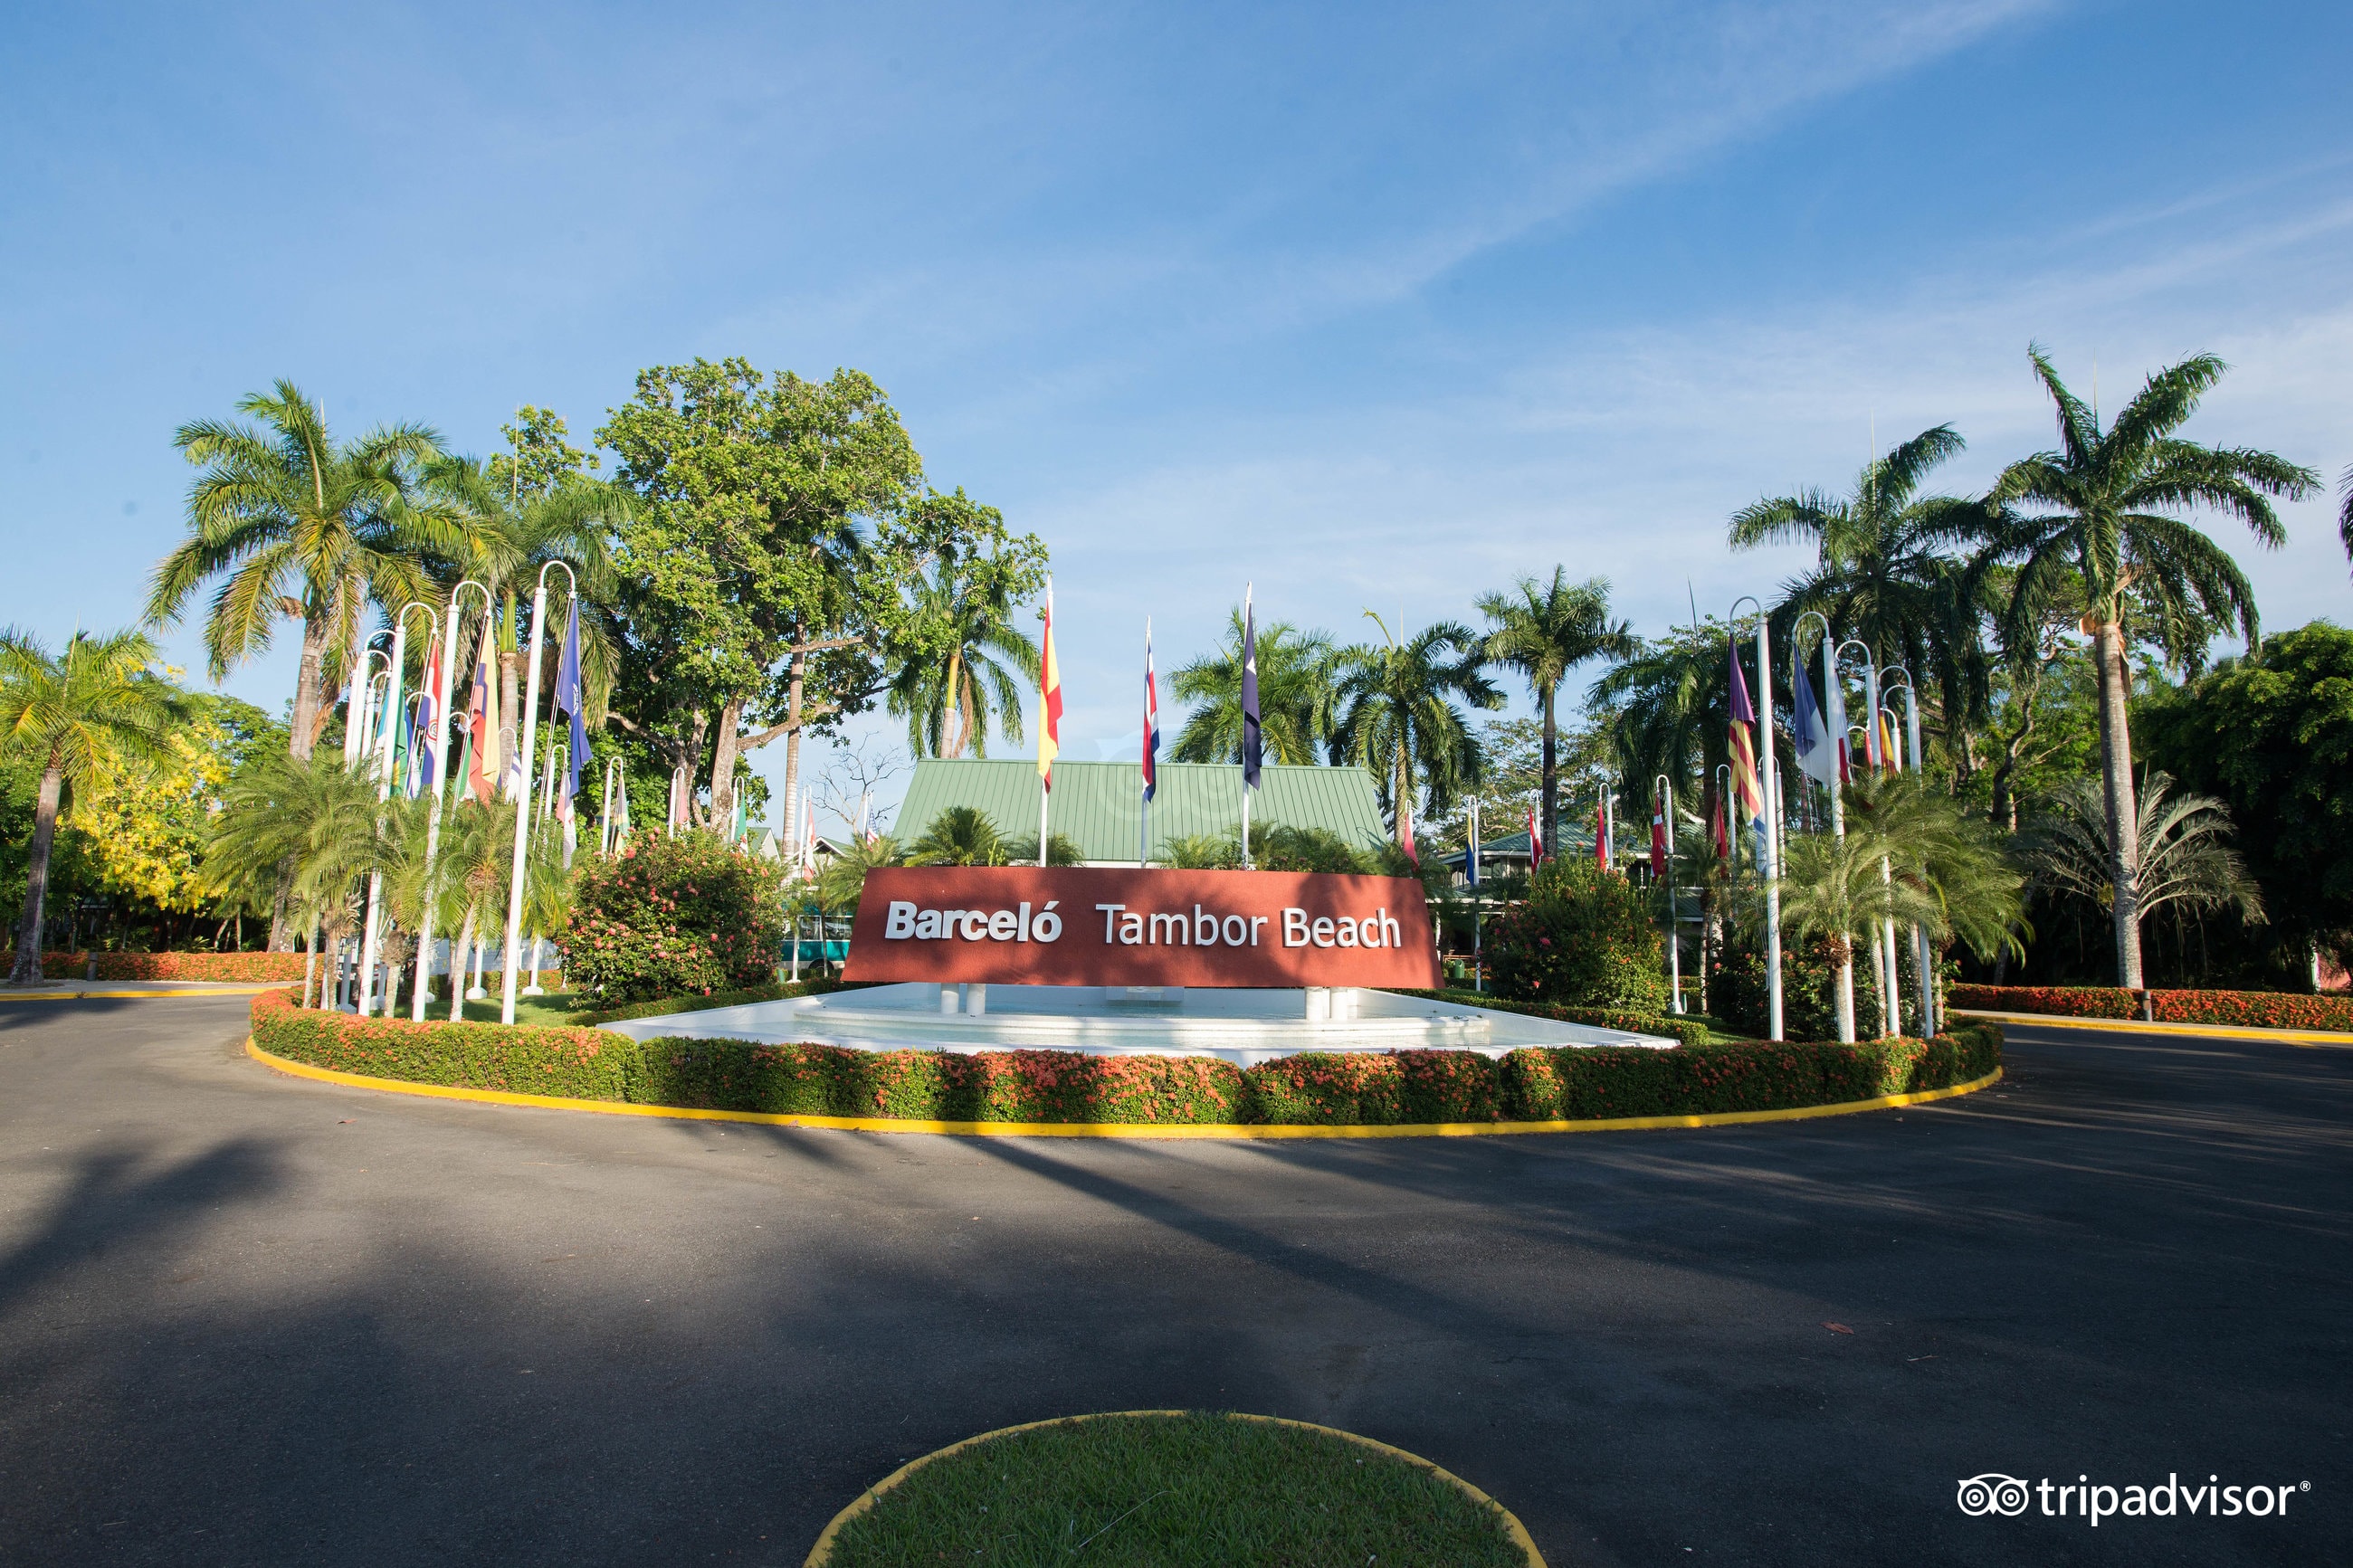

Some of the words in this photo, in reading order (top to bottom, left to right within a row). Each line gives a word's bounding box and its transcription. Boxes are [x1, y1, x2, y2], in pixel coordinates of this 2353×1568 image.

[884, 900, 1062, 943] Barceló
[1095, 904, 1269, 946] Tambor
[1282, 907, 1402, 948] Beach
